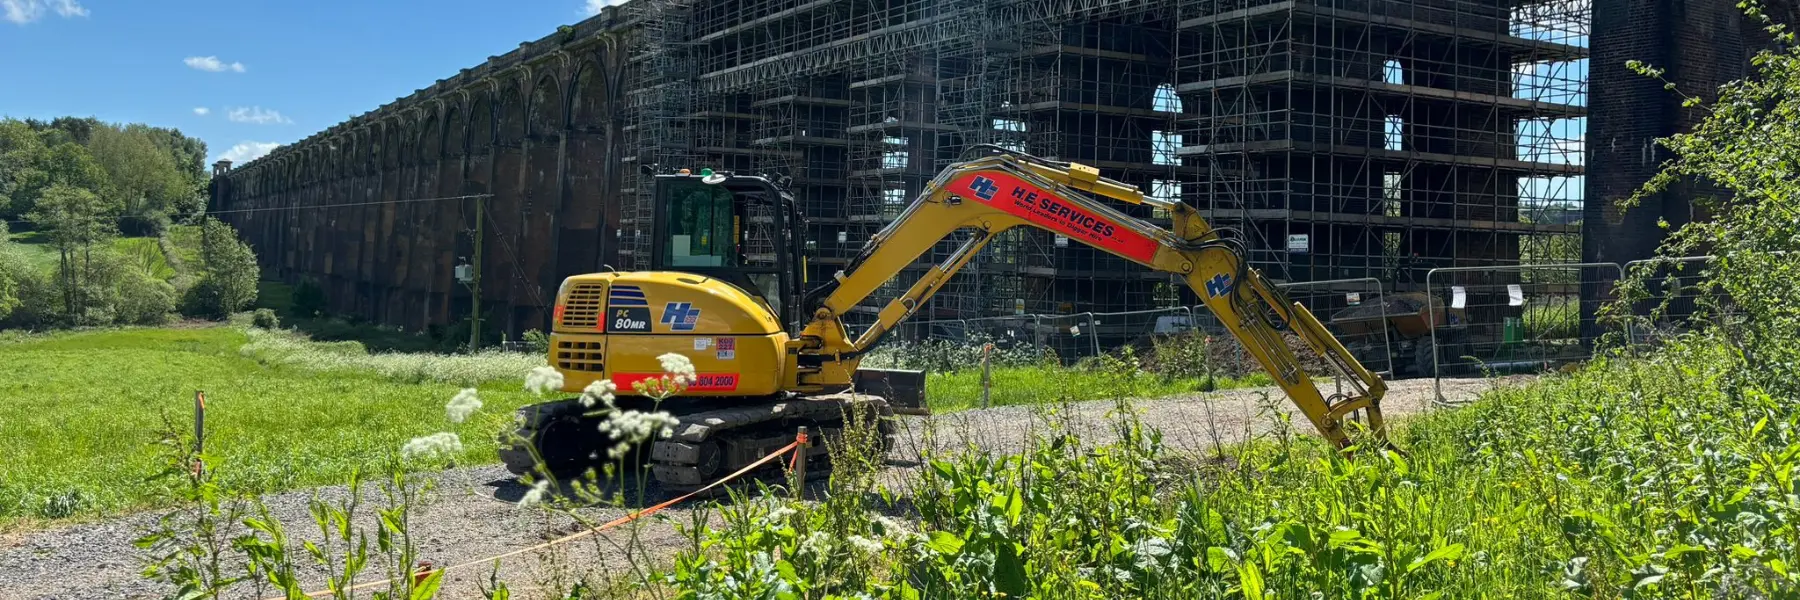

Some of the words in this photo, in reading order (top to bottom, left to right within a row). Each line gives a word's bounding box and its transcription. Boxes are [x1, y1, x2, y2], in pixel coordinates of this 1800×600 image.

[1014, 199, 1032, 212] World
[1033, 208, 1058, 223] Leaders
[1067, 222, 1087, 236] Digger
[1088, 232, 1103, 242] Hire
[1039, 198, 1115, 237] SERVICES
[616, 309, 629, 318] PC
[614, 318, 646, 329] 80MR
[698, 376, 713, 386] 804
[715, 376, 733, 386] 2000
